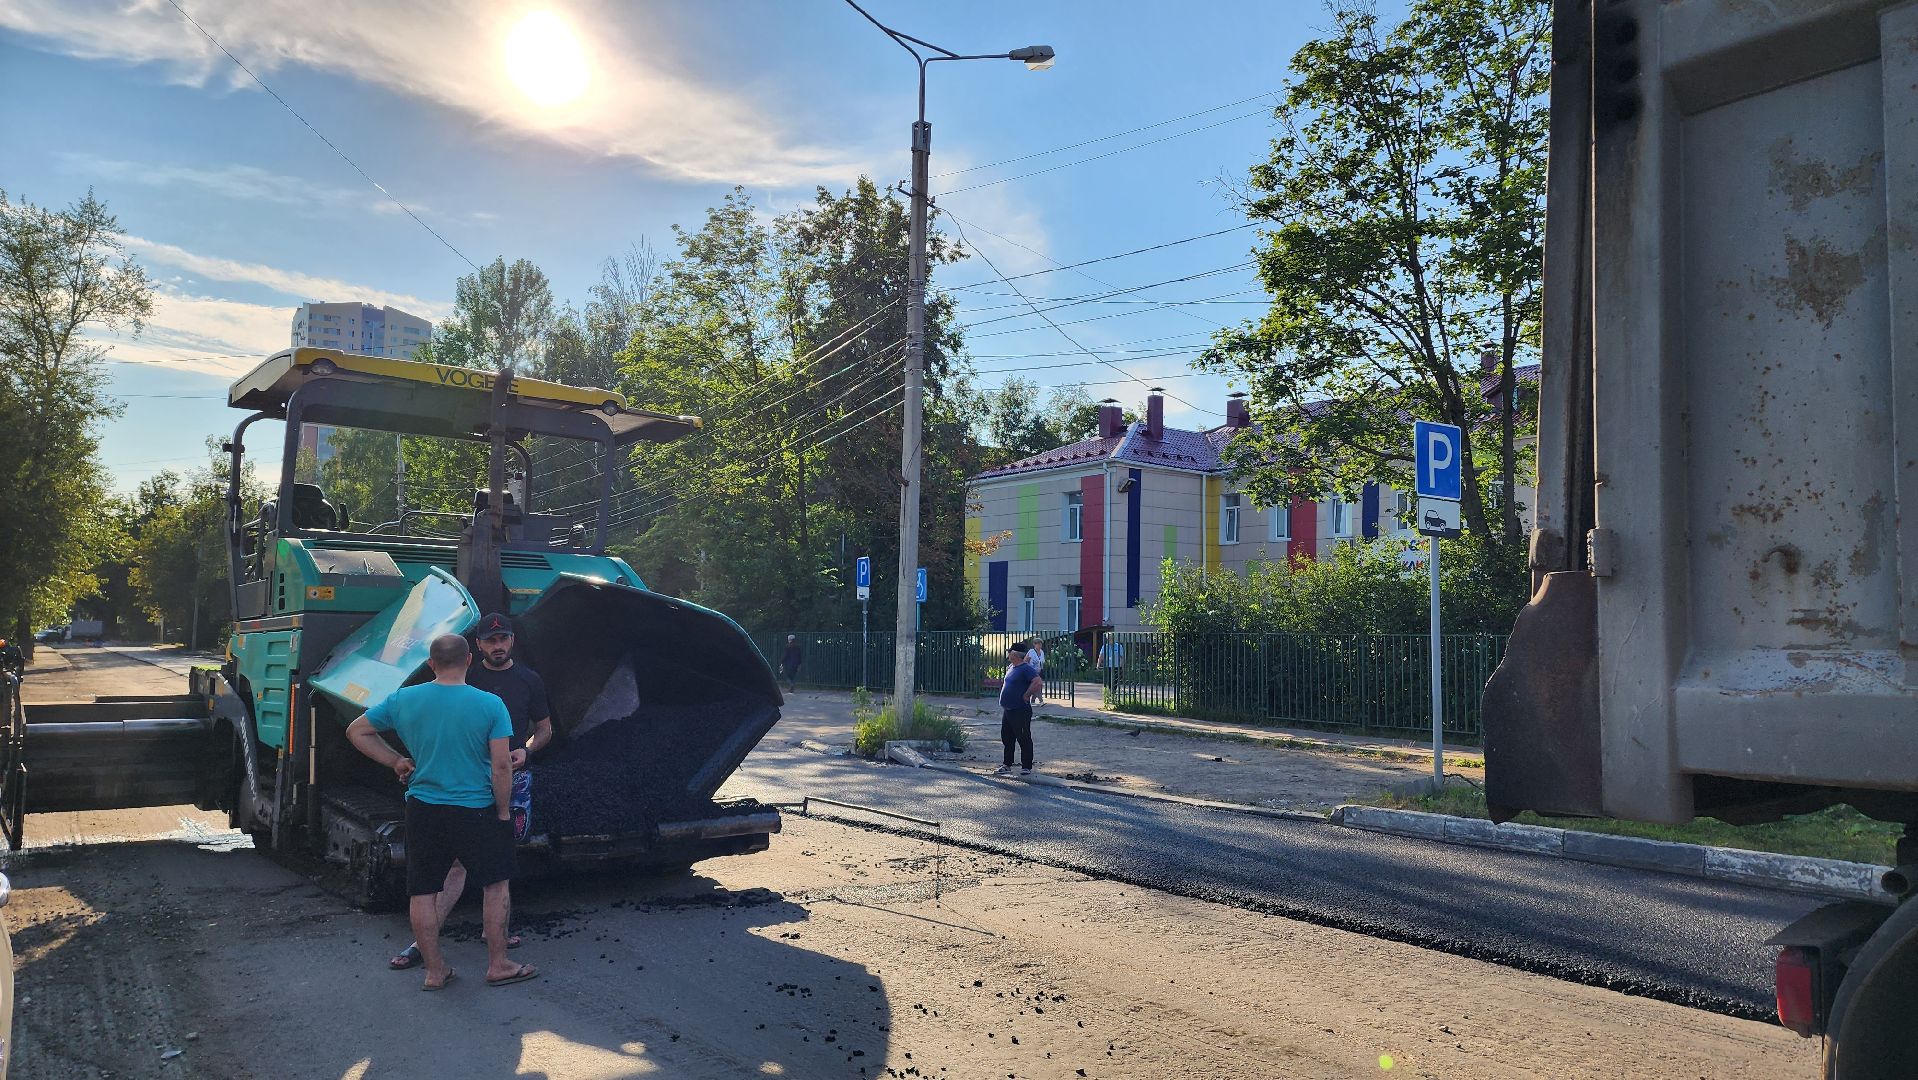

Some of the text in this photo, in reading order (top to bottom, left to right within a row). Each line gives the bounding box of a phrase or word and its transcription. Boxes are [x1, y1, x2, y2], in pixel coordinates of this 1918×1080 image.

[435, 367, 519, 393] VOGEE
[1428, 431, 1453, 489] P
[860, 561, 868, 584] P
